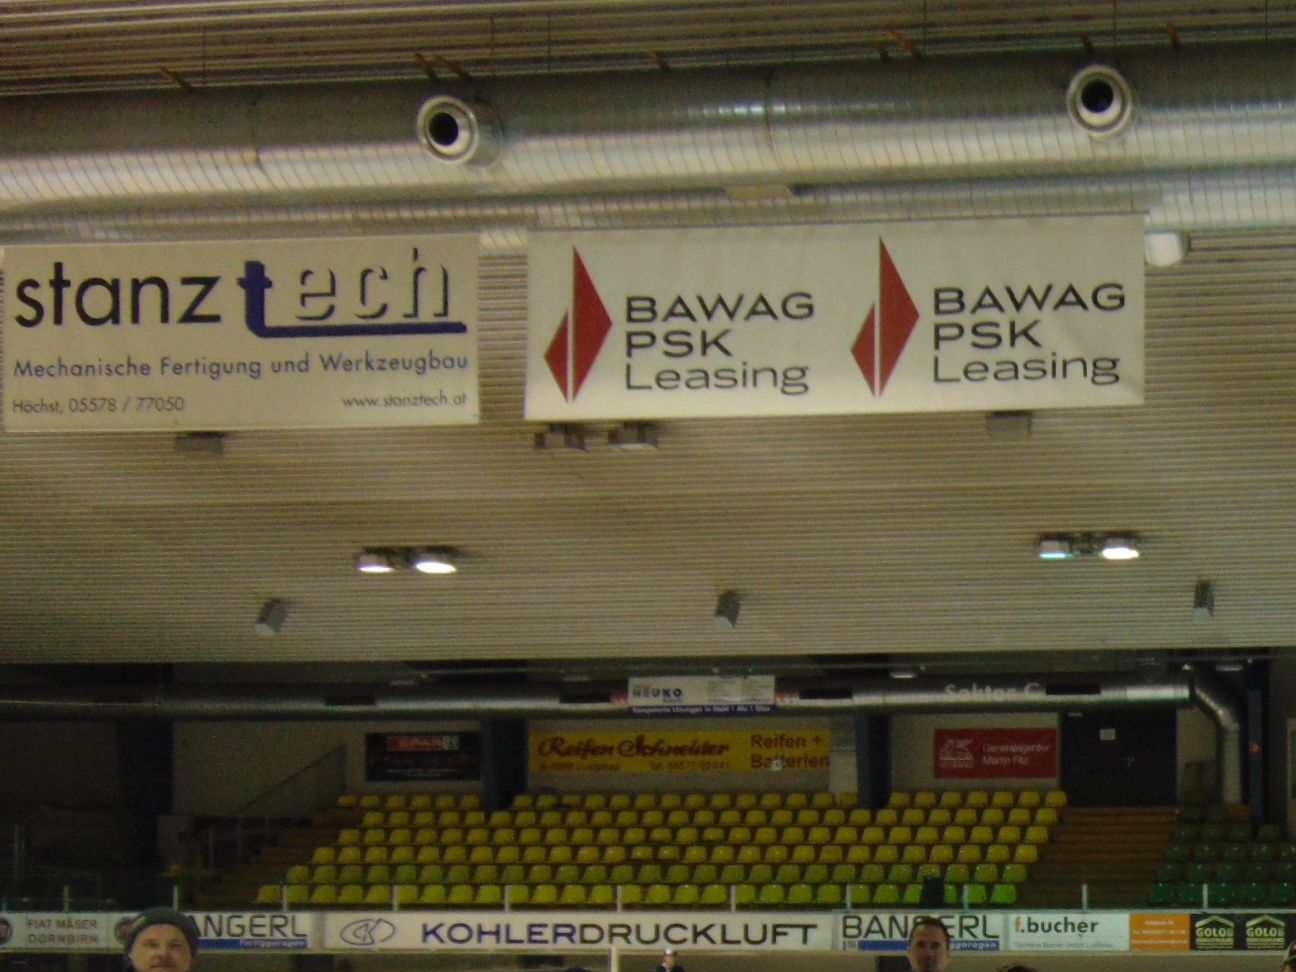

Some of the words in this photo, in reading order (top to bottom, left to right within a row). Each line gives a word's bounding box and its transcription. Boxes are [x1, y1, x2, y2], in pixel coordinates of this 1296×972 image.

[625, 291, 816, 324] BAWAG
[934, 282, 1126, 316] BAWAG
[625, 330, 734, 359] PSK
[934, 320, 1042, 351] PSK
[12, 357, 152, 379] Mechanische
[160, 356, 262, 381] Fertigung
[271, 355, 310, 375] und
[318, 350, 469, 379] Werkzeugbau
[625, 363, 809, 396] Leasing
[934, 353, 1121, 385] Leasing
[68, 397, 118, 413] 05578
[135, 395, 185, 412] 77050
[945, 681, 1016, 700] Sektor
[751, 732, 807, 750] Reifen
[190, 914, 308, 938] NGERL
[842, 913, 999, 940] BANERL
[948, 939, 998, 952] ggaragen
